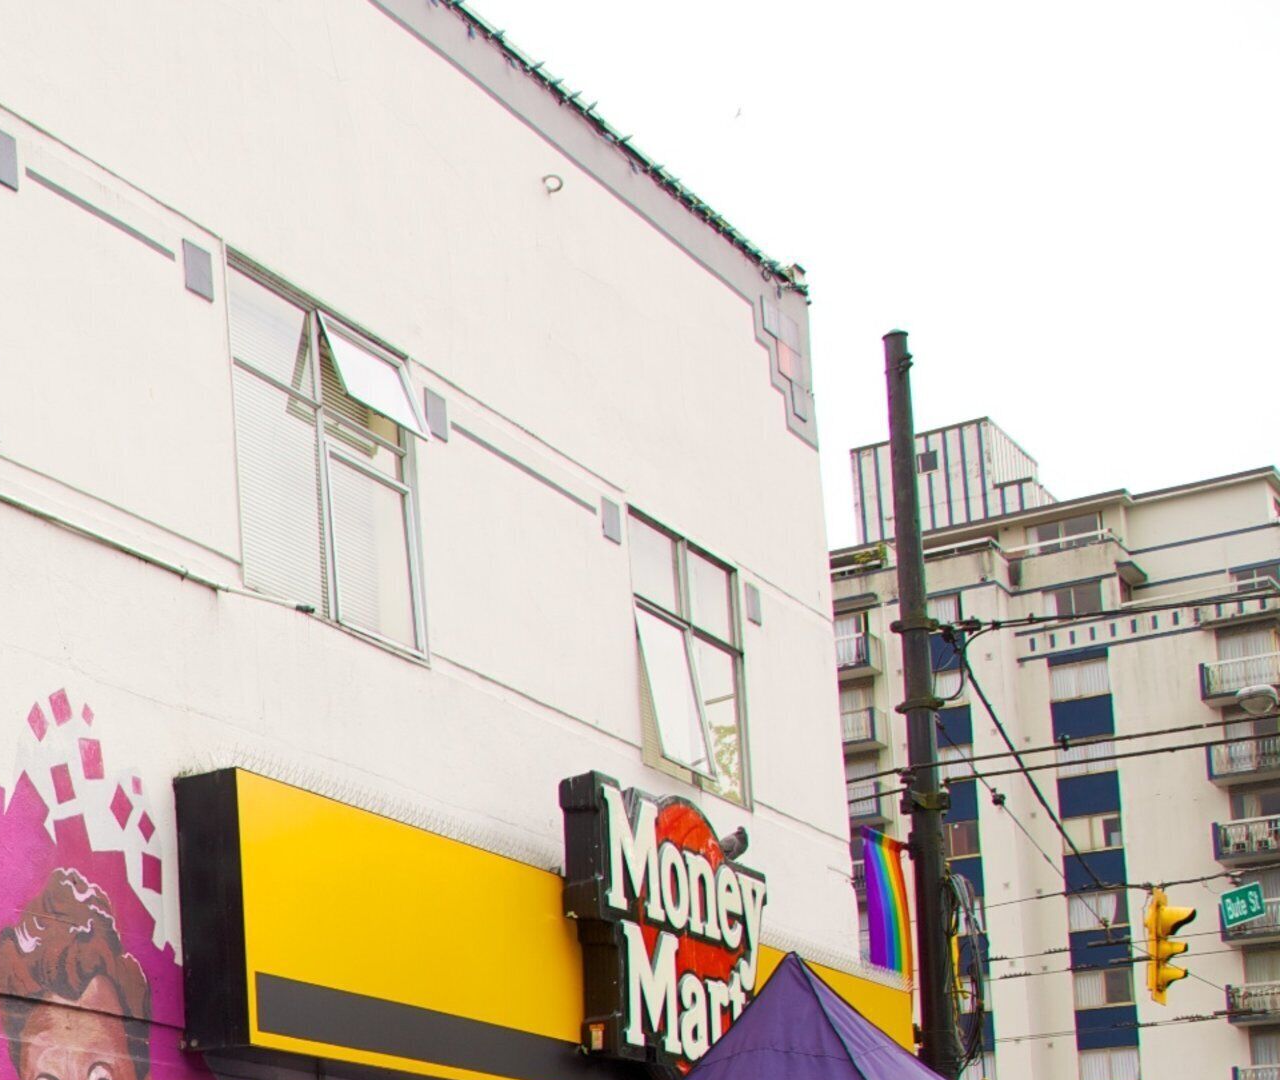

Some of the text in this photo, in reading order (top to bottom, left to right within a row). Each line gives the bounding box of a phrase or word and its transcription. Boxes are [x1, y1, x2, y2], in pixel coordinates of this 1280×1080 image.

[603, 783, 765, 991] Money
[1225, 890, 1261, 919] Bute St
[622, 920, 746, 1061] Mart
